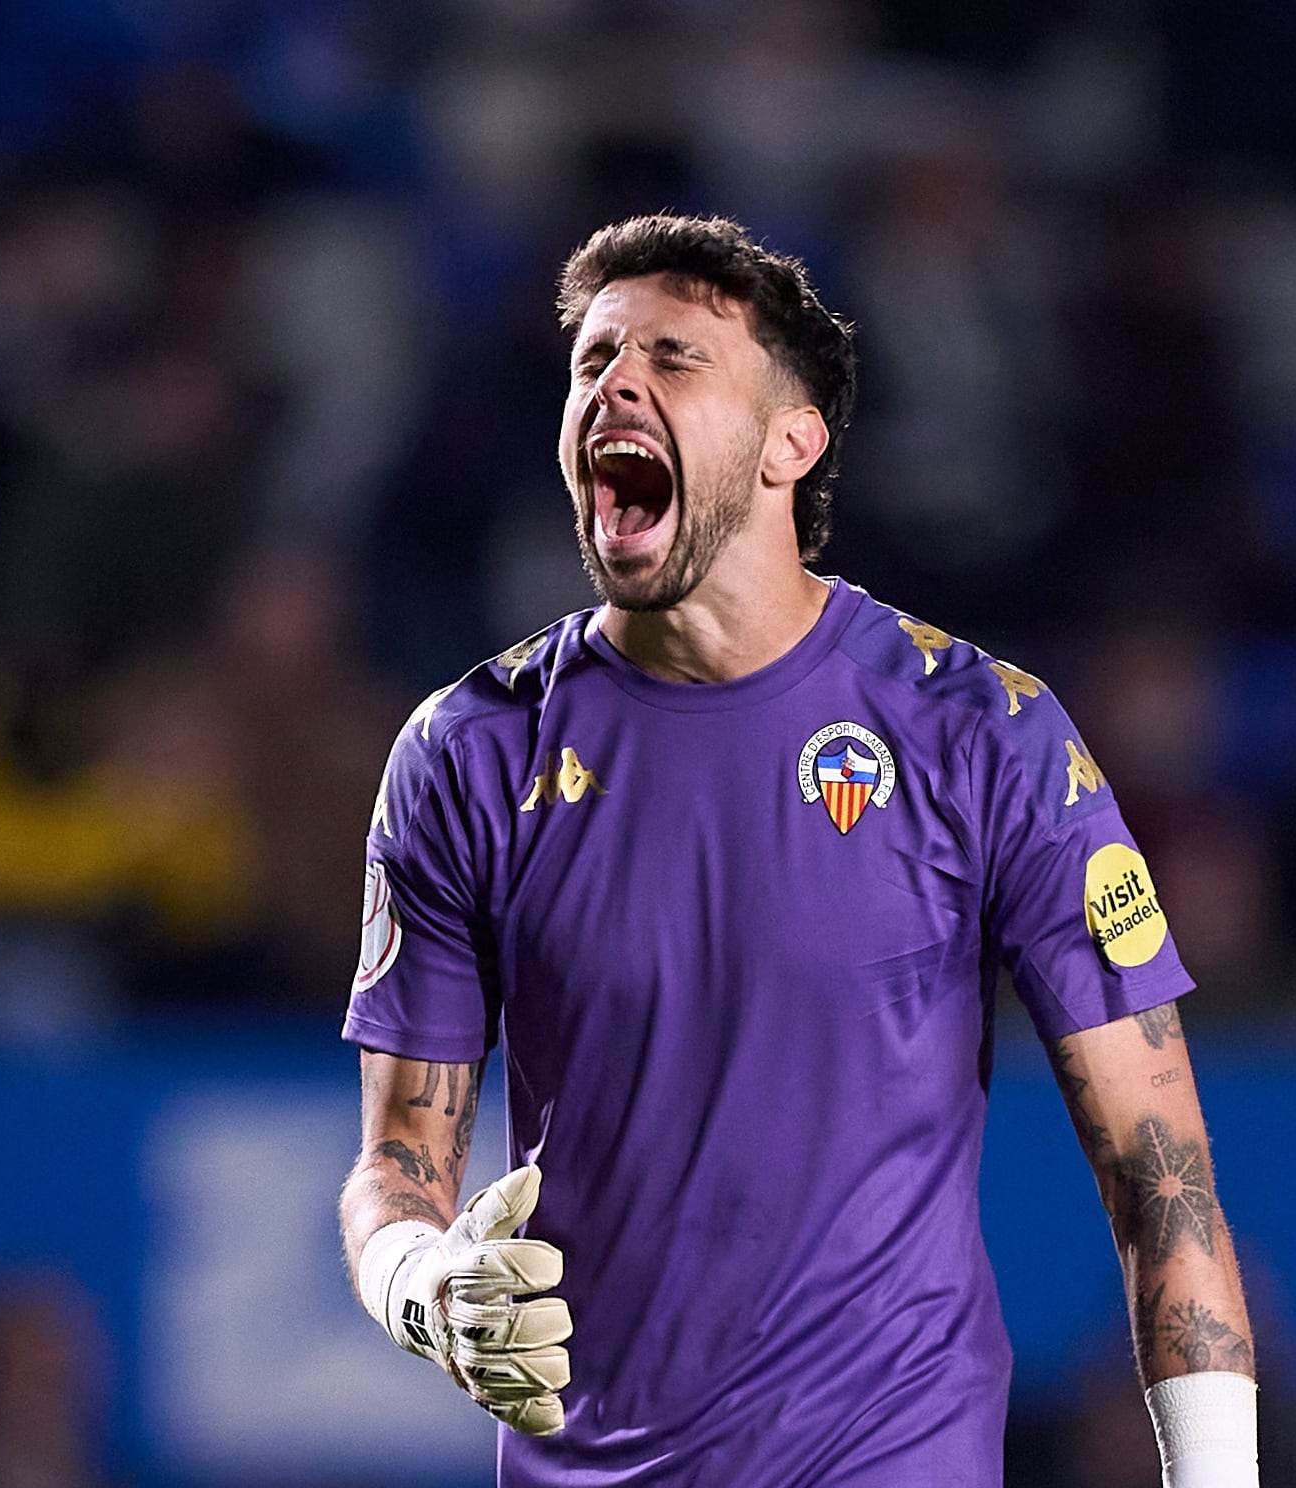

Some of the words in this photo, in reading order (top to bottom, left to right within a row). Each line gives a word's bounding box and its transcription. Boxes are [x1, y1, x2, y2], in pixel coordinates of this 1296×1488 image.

[800, 752, 816, 796] CENTRE
[808, 724, 862, 752] D'ESPORTS
[862, 733, 894, 781] SABADELL
[1089, 869, 1145, 919] visit
[1095, 895, 1160, 947] Sabadel
